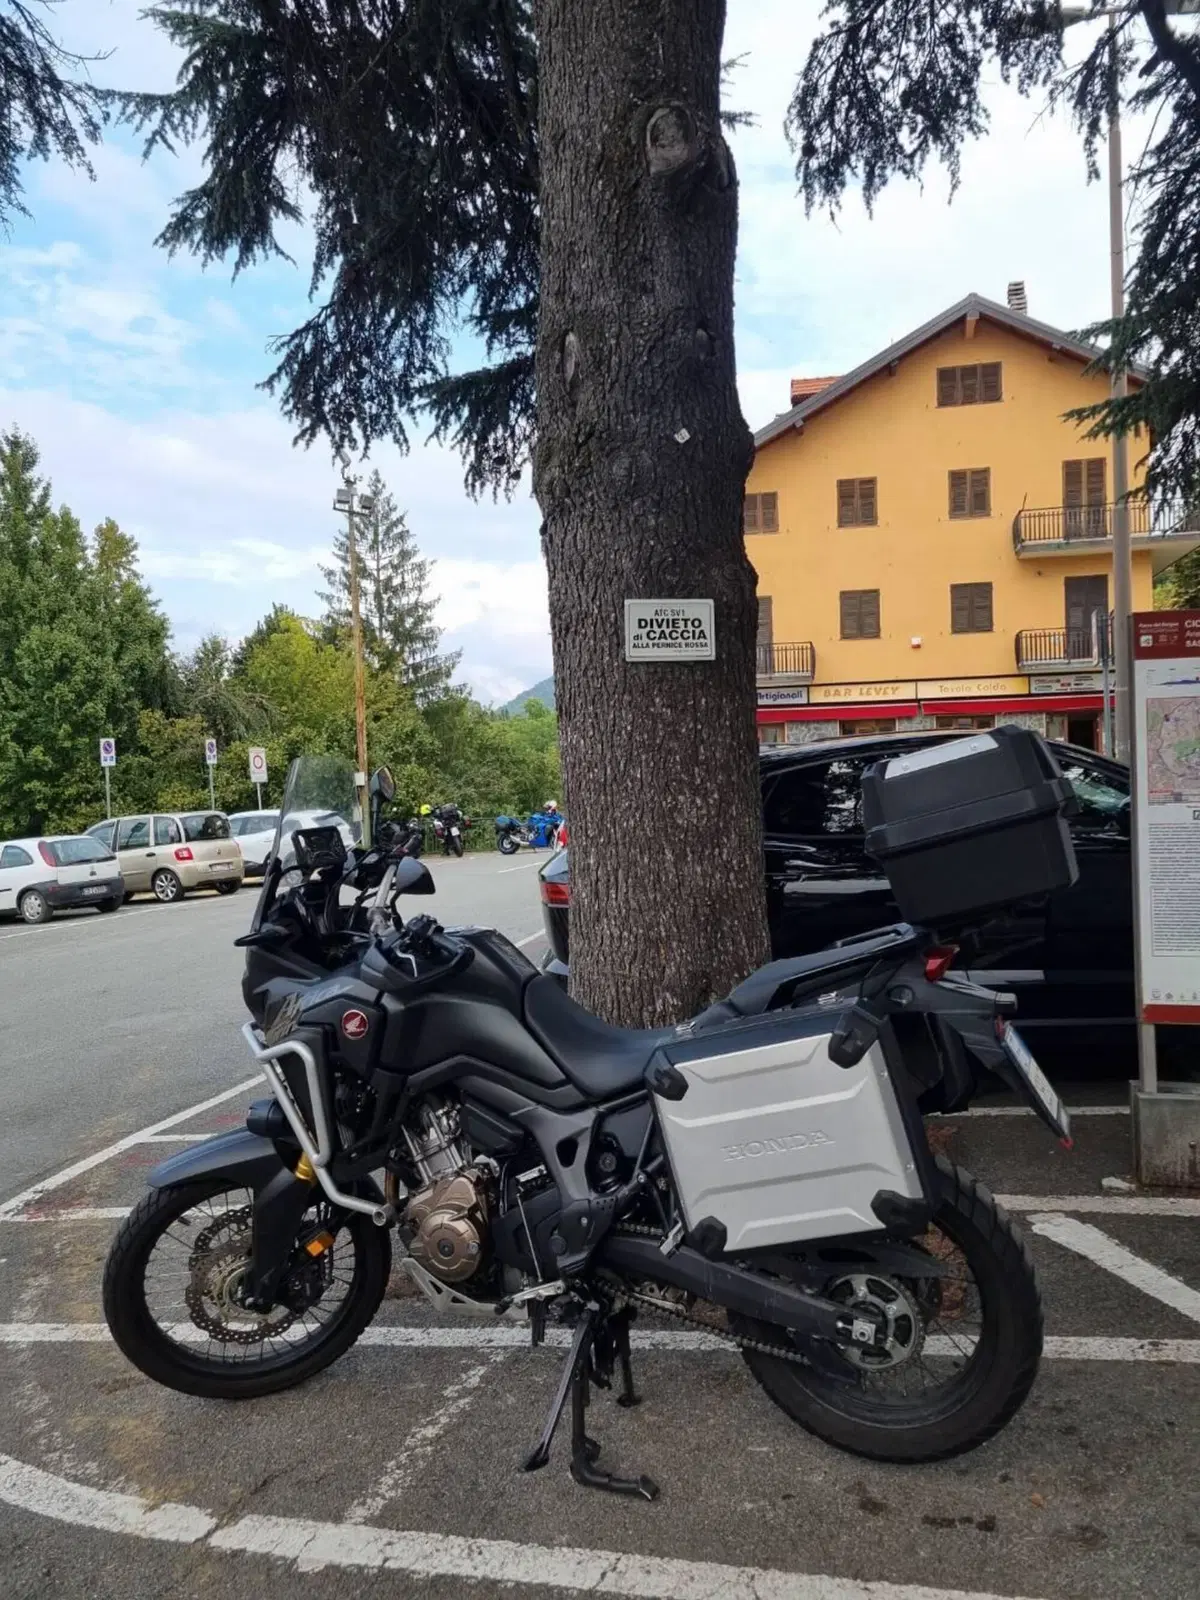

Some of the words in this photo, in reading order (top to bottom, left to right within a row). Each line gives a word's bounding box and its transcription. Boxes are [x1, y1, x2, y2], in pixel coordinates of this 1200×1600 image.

[637, 618, 702, 629] DIVIETO
[633, 633, 643, 641] di
[646, 629, 708, 641] CACCIA
[632, 641, 650, 649] ALLA
[651, 641, 683, 649] PERNICE
[684, 641, 709, 649] ROSSA
[823, 688, 852, 698] BAR
[720, 1130, 836, 1162] HONDA
